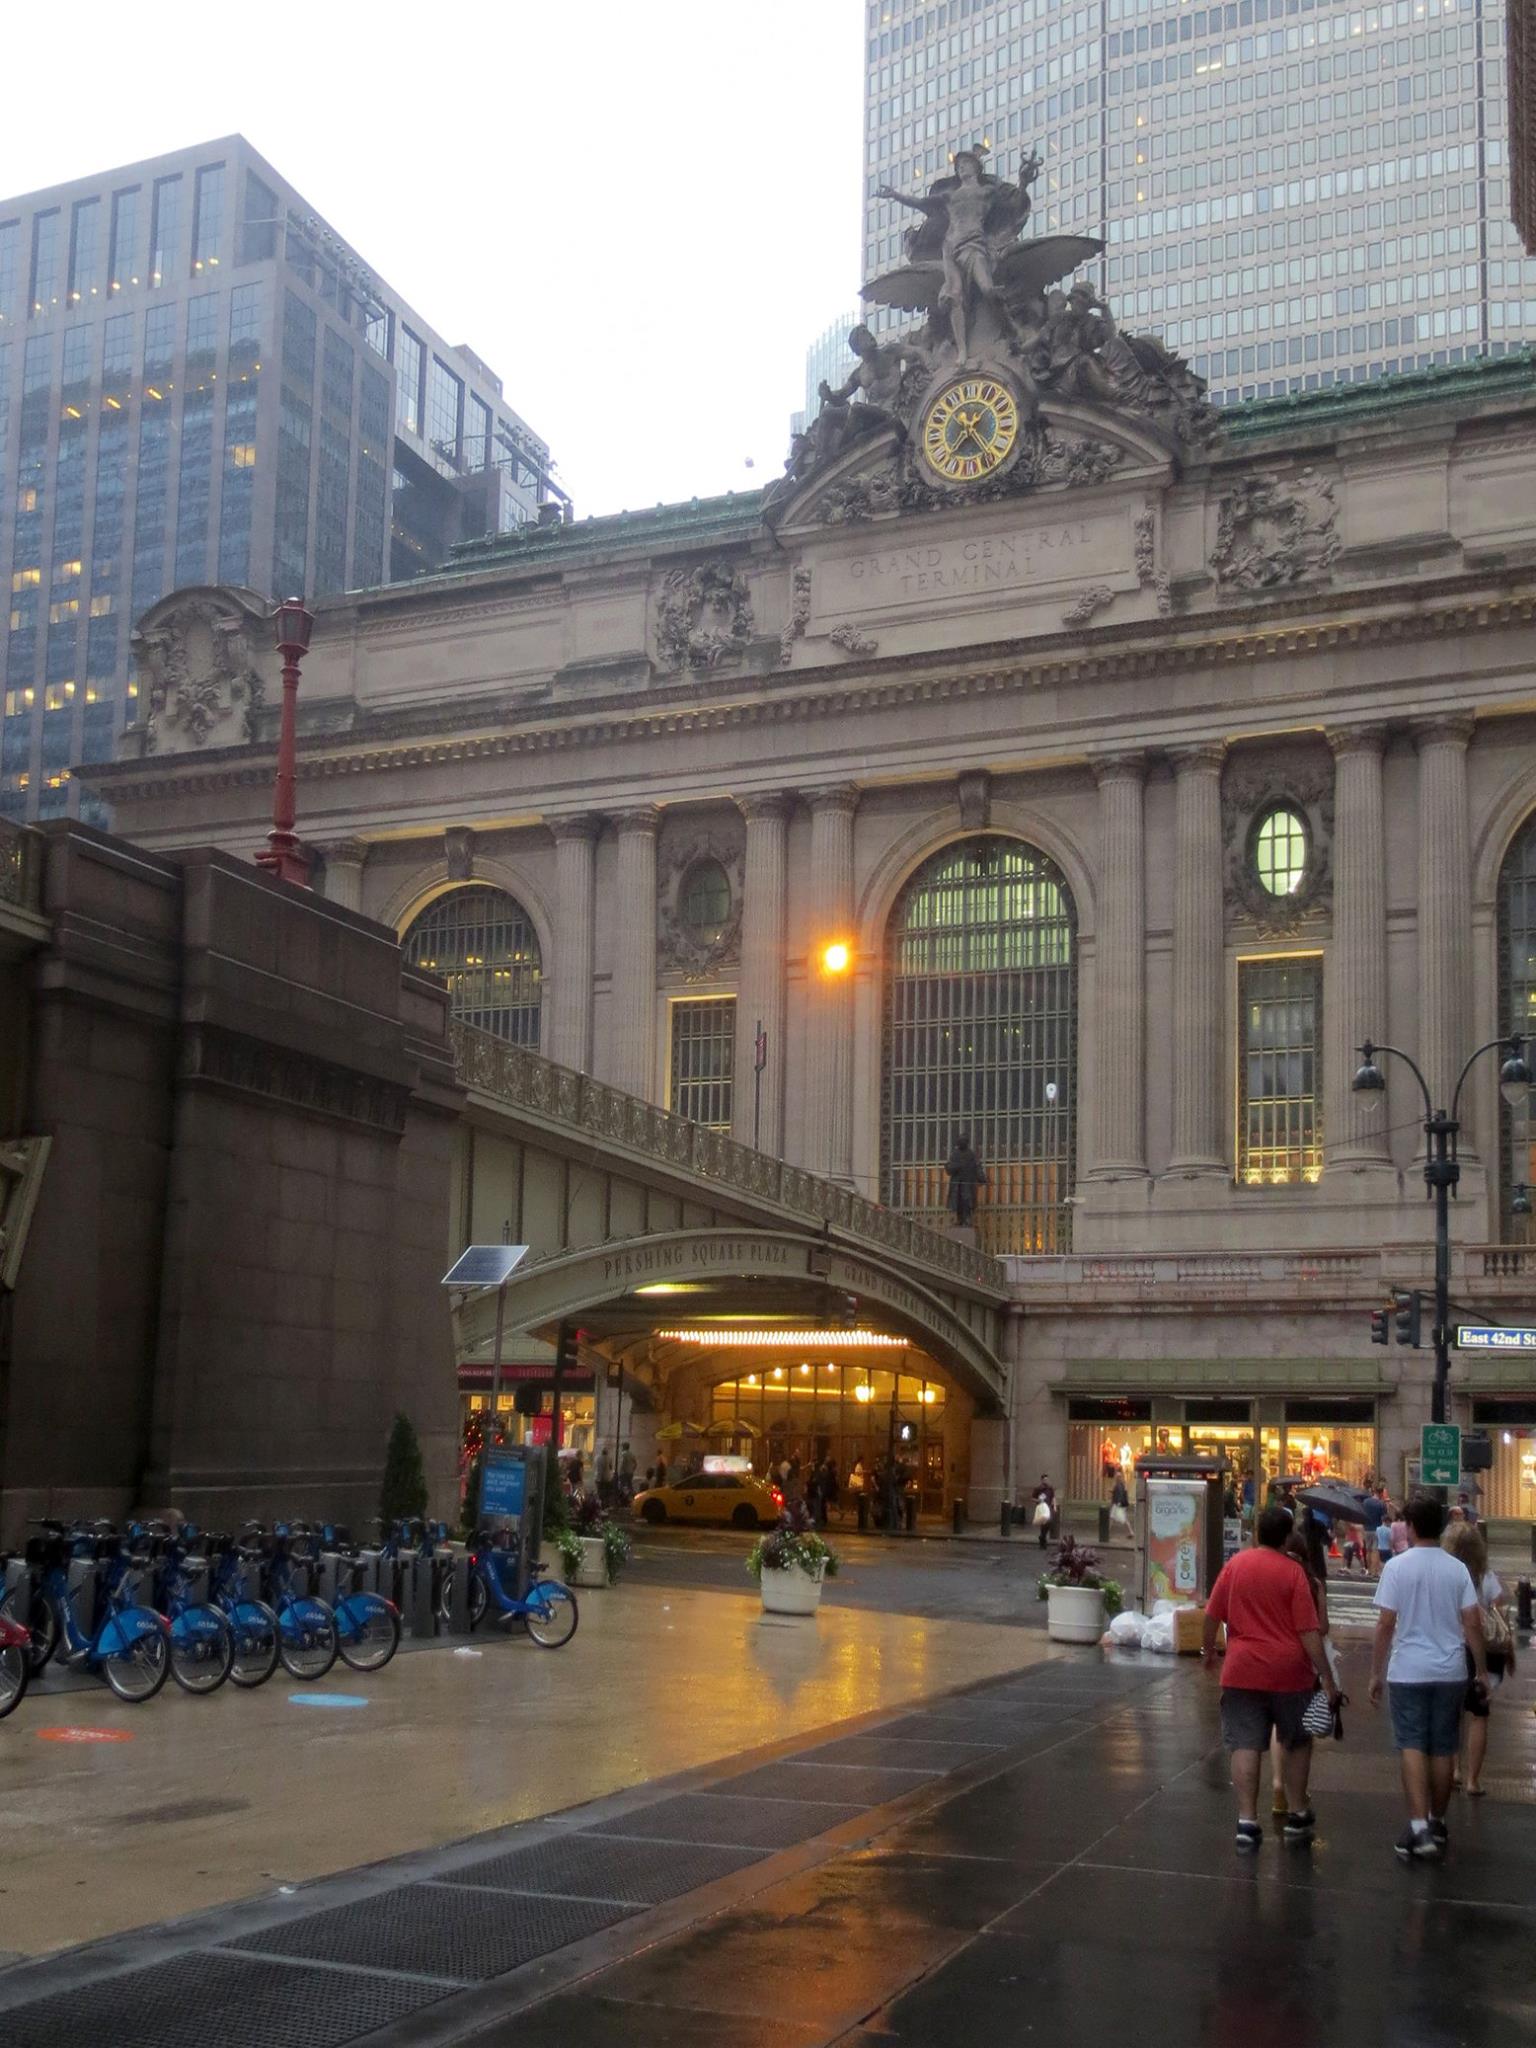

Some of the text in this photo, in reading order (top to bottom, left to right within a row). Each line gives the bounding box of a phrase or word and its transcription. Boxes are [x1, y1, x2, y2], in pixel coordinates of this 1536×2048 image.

[850, 525, 1091, 578] GRAND CENTRAL
[901, 556, 1037, 593] TERMINAL
[604, 1242, 787, 1279] PERSHING SQUARE PLAZA
[845, 1265, 878, 1291] GRAND
[1462, 1331, 1489, 1344] East
[1491, 1332, 1521, 1345] 42nd
